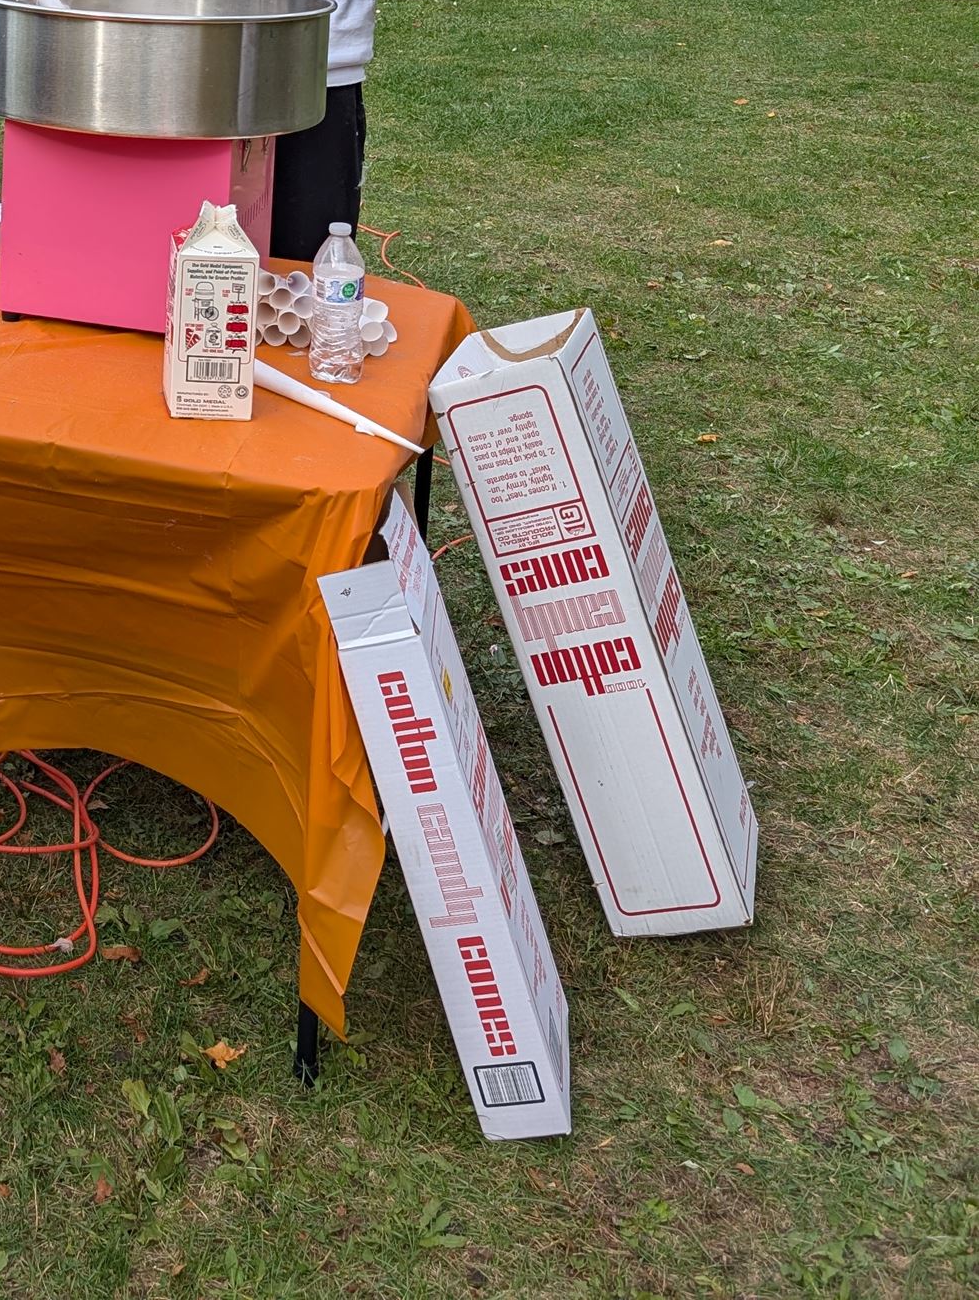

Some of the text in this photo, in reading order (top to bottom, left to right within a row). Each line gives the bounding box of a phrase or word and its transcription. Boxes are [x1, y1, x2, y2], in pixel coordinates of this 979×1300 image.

[508, 411, 534, 422] sponge.
[497, 427, 513, 436] over
[515, 420, 537, 432] lightly
[467, 433, 487, 443] damp
[470, 430, 540, 453] open end of cones
[497, 444, 517, 456] helps
[516, 445, 523, 453] it
[522, 440, 543, 450] easily,
[474, 451, 490, 462] pass
[513, 452, 523, 463] up
[521, 449, 538, 461] pick
[538, 449, 547, 457] To
[477, 462, 495, 471] more
[495, 457, 513, 467] Floss
[484, 472, 518, 485] separate.
[528, 473, 554, 485] tightly,
[506, 480, 528, 491] firmly
[528, 484, 550, 495] cones
[551, 483, 558, 492] If
[490, 495, 504, 504] too
[511, 525, 556, 539] PRODUCTS
[531, 531, 554, 540] GOLD
[499, 544, 610, 597] cones
[510, 588, 626, 652] candy
[530, 636, 641, 697] cotton
[377, 670, 438, 795] cotton
[417, 802, 483, 928] candy
[457, 935, 517, 1058] cones
